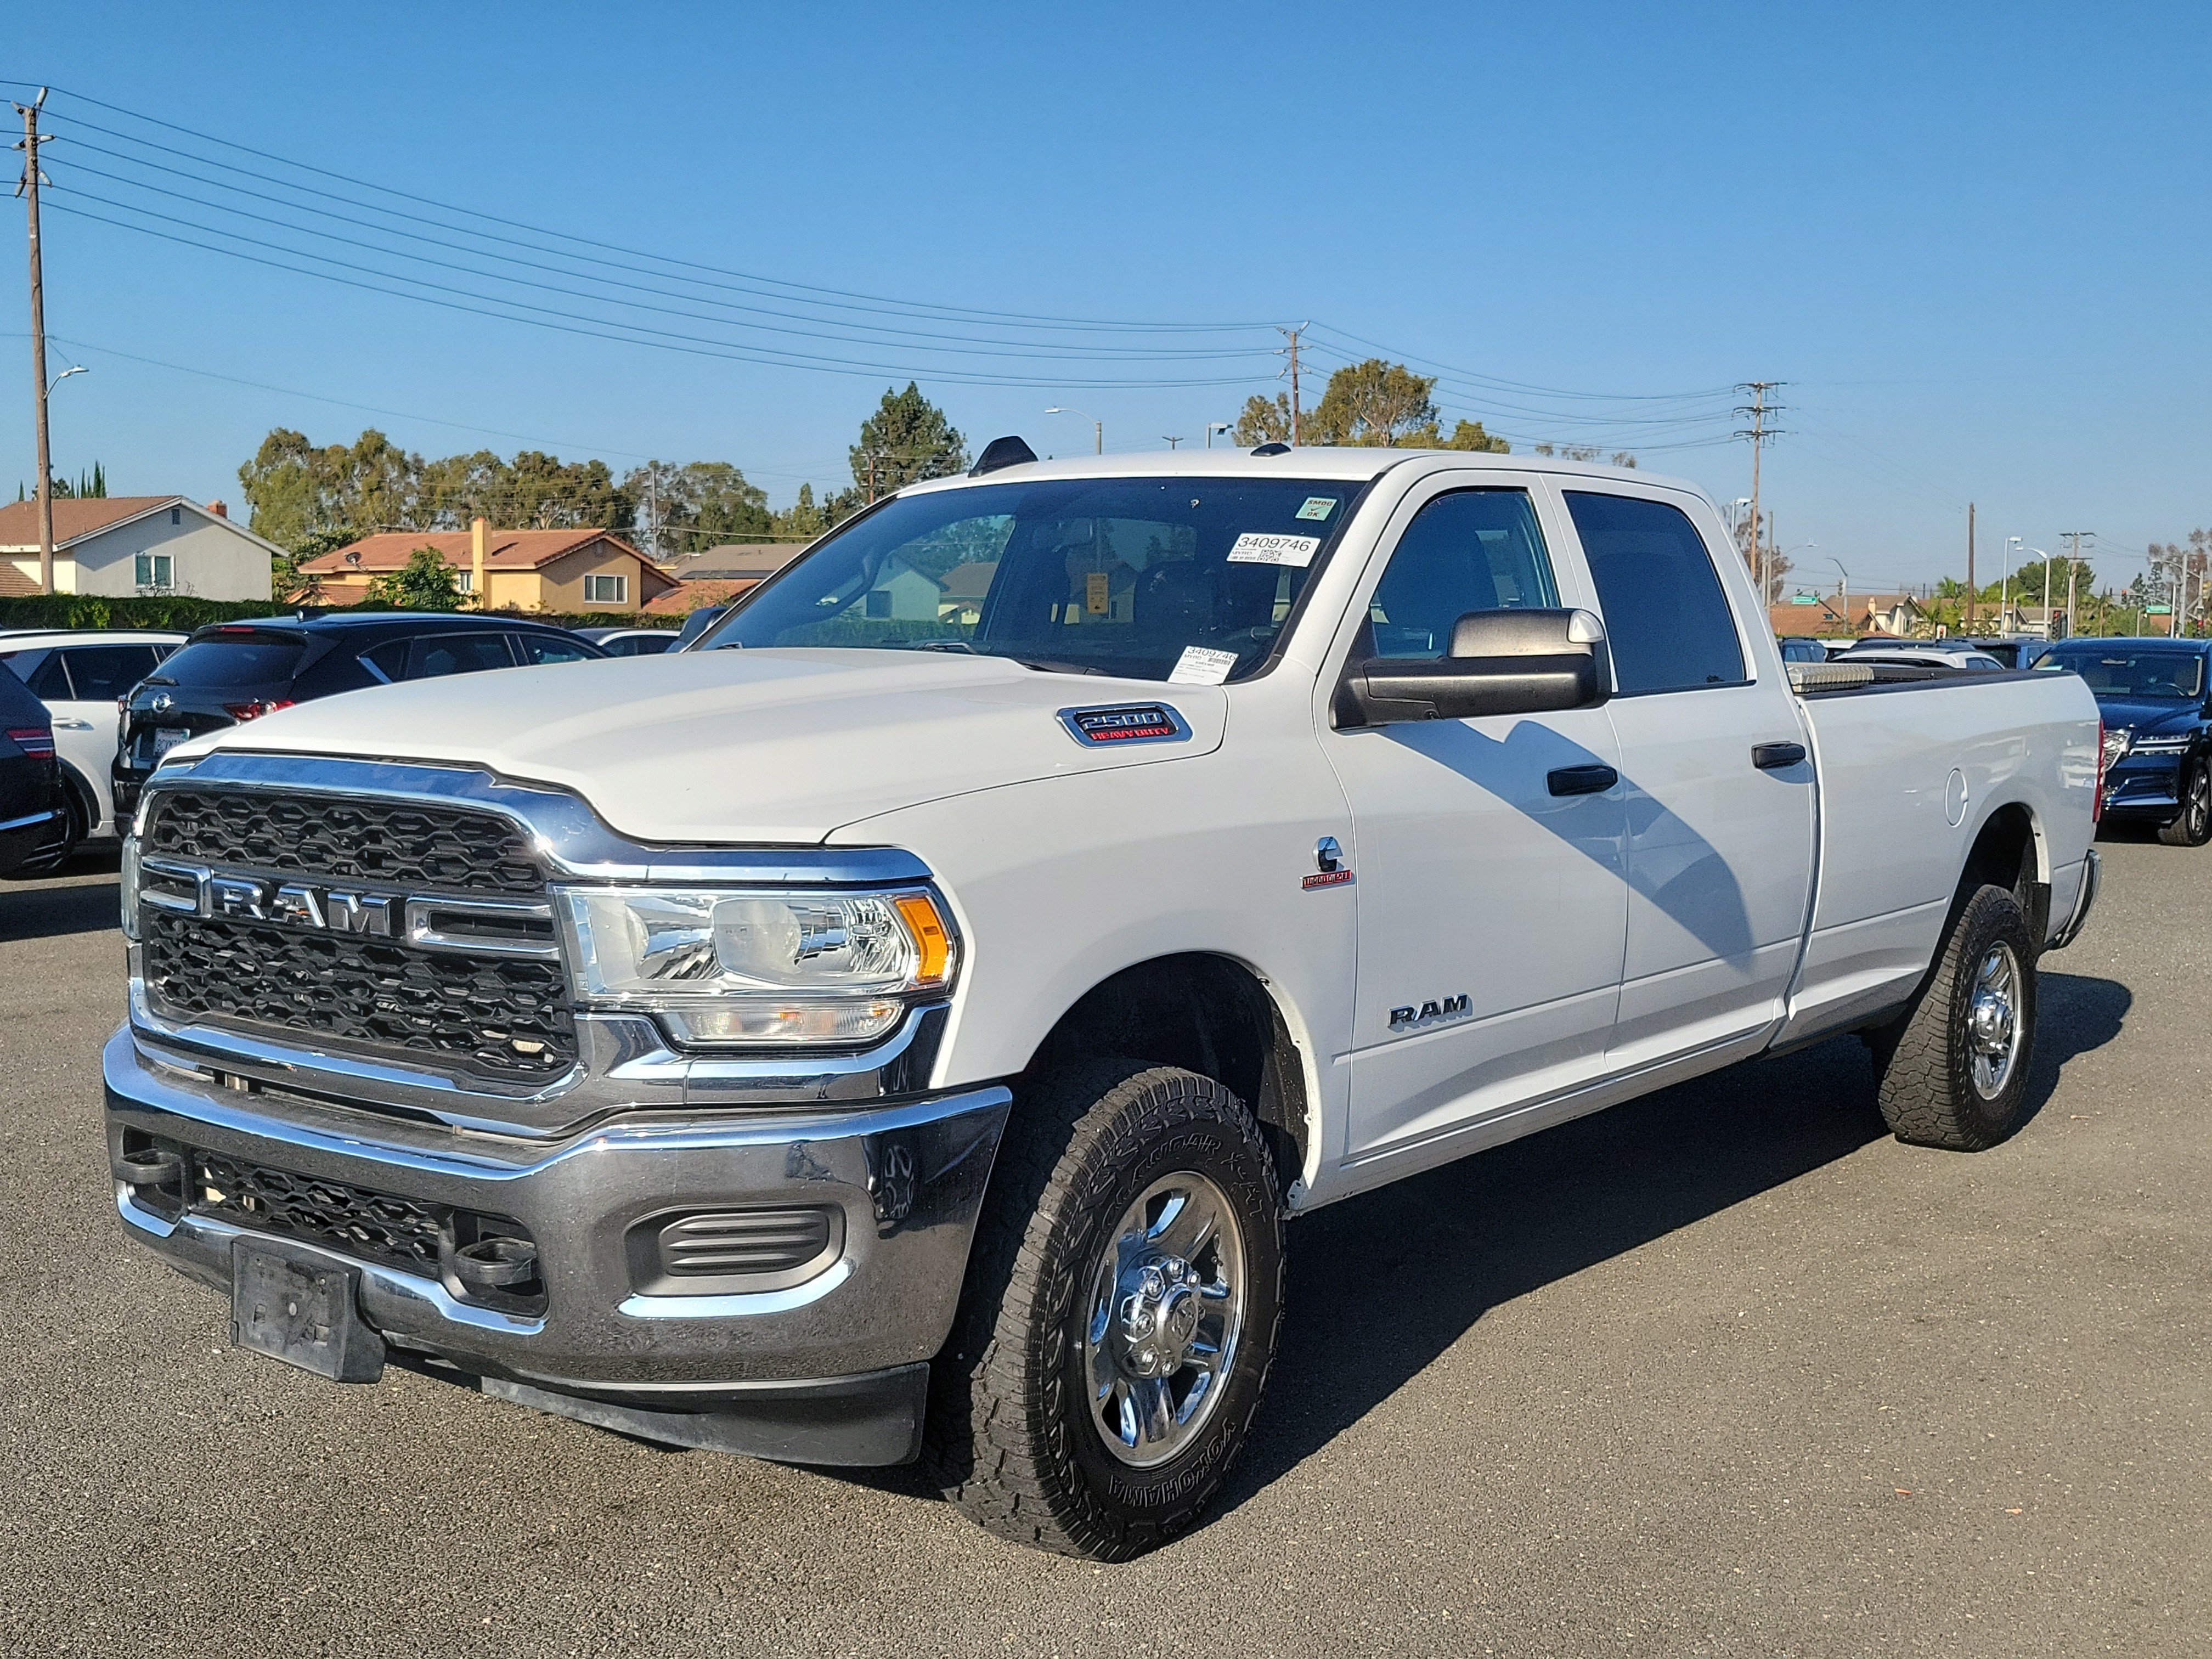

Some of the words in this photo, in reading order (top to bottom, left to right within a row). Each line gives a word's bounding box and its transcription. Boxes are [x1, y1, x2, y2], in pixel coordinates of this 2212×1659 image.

[1238, 537, 1311, 552] 3409746
[1187, 647, 1237, 661] 3409746
[1080, 713, 1163, 730] 2500
[212, 879, 393, 938] RAM
[1388, 993, 1468, 1026] RAM
[1109, 1417, 1236, 1508] YOKOHAMA
